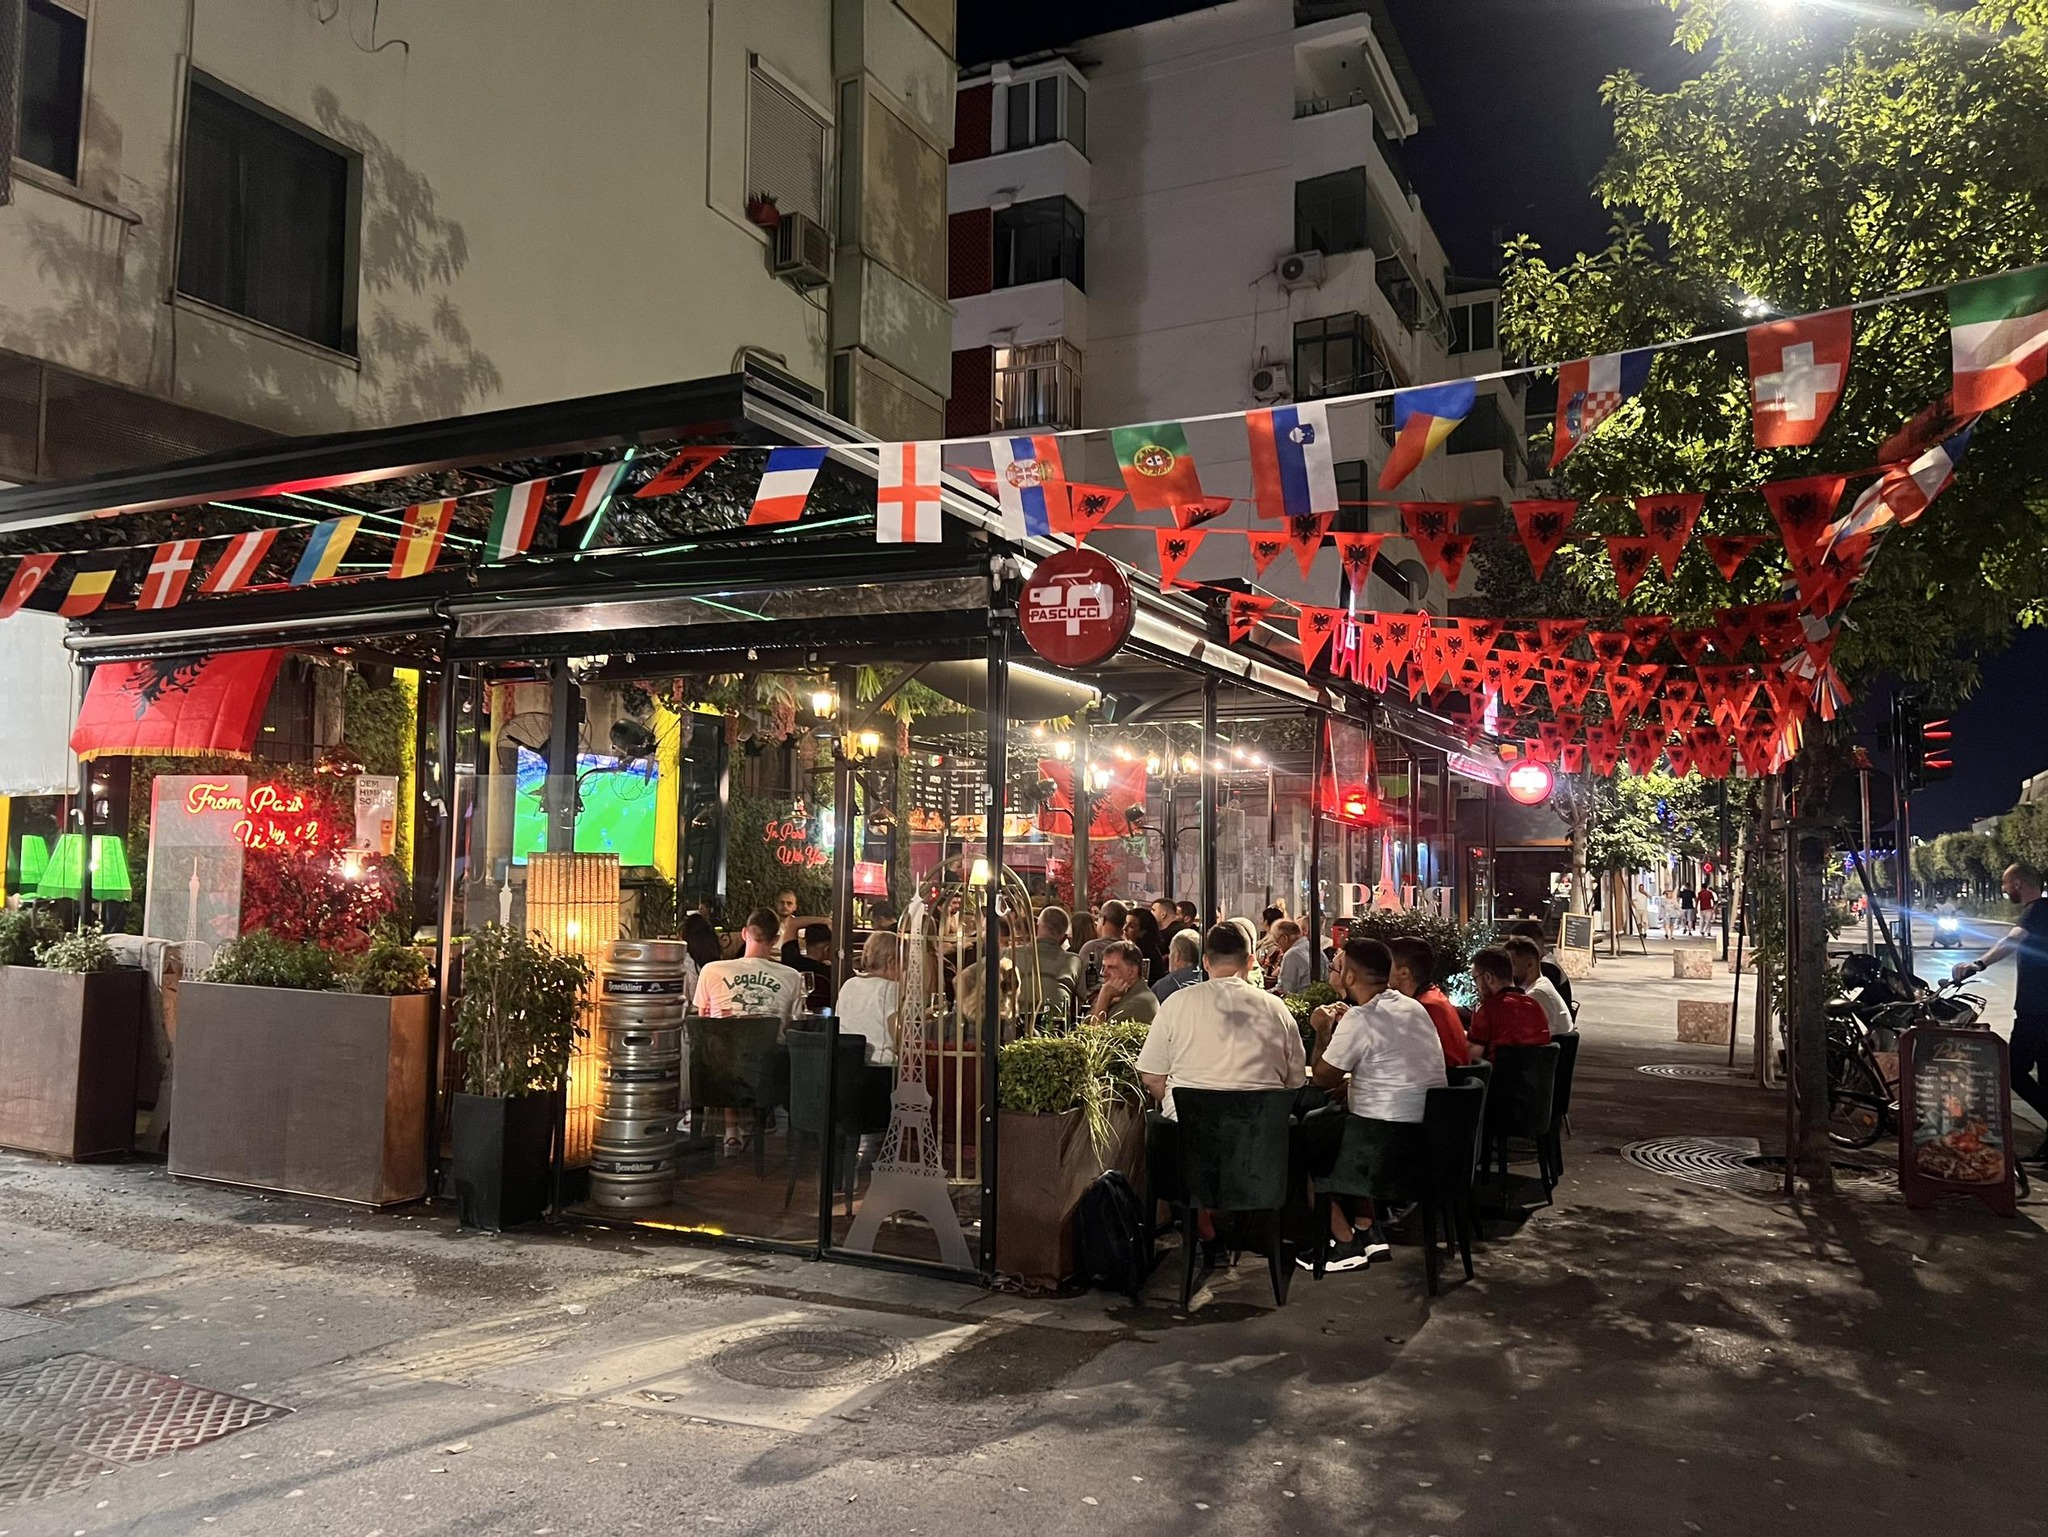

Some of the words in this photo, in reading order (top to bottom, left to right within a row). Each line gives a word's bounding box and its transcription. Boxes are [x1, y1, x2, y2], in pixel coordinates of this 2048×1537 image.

[1030, 607, 1100, 621] PASCUCCI
[359, 780, 379, 788] DEM
[186, 783, 244, 814] From
[722, 971, 782, 993] Legalize
